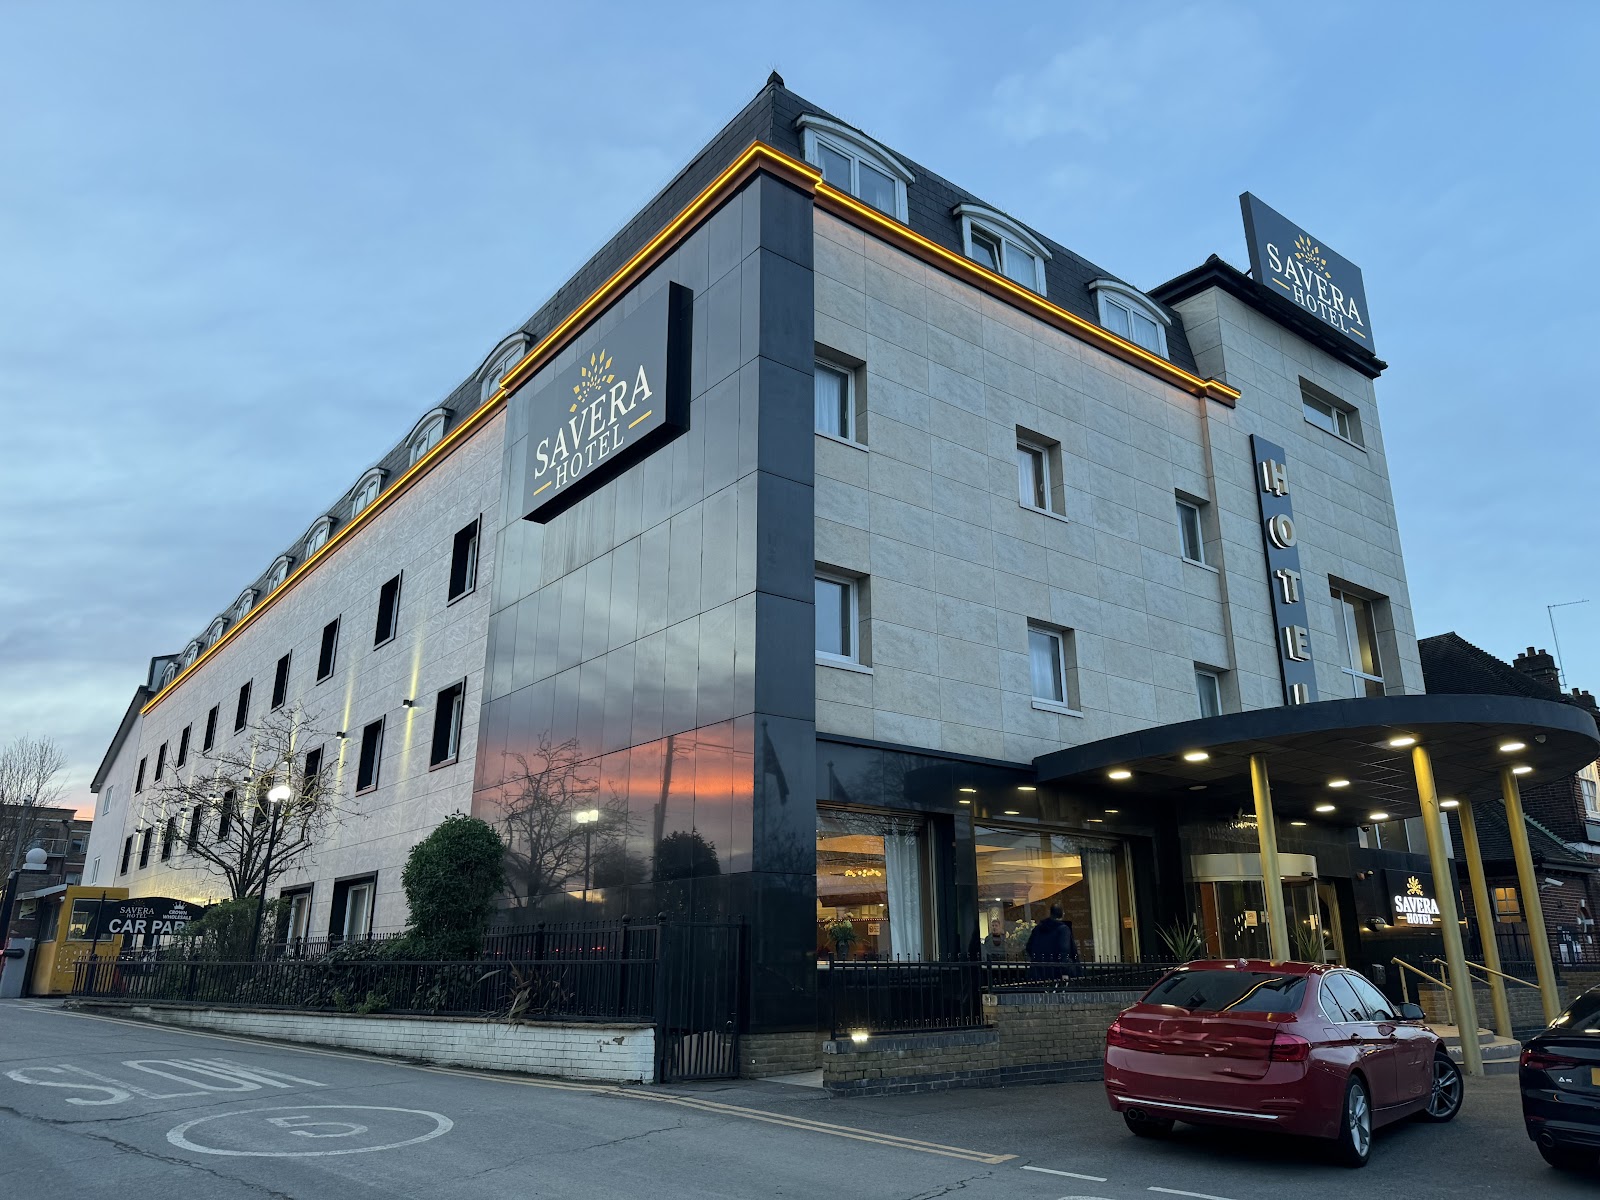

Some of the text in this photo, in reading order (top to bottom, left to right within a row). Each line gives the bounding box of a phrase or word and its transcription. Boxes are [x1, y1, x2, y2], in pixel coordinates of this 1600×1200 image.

[1266, 243, 1364, 327] SAVERA
[1292, 284, 1349, 334] HOTEL
[534, 364, 653, 479] SAVERA
[554, 424, 625, 490] HOTEL
[119, 906, 155, 915] SAVERA
[1394, 895, 1440, 914] SAVERA
[1406, 913, 1434, 925] HOTEL
[108, 918, 187, 935] CAR PAR
[2, 1057, 329, 1106] SLOW
[266, 1115, 368, 1138] 5
